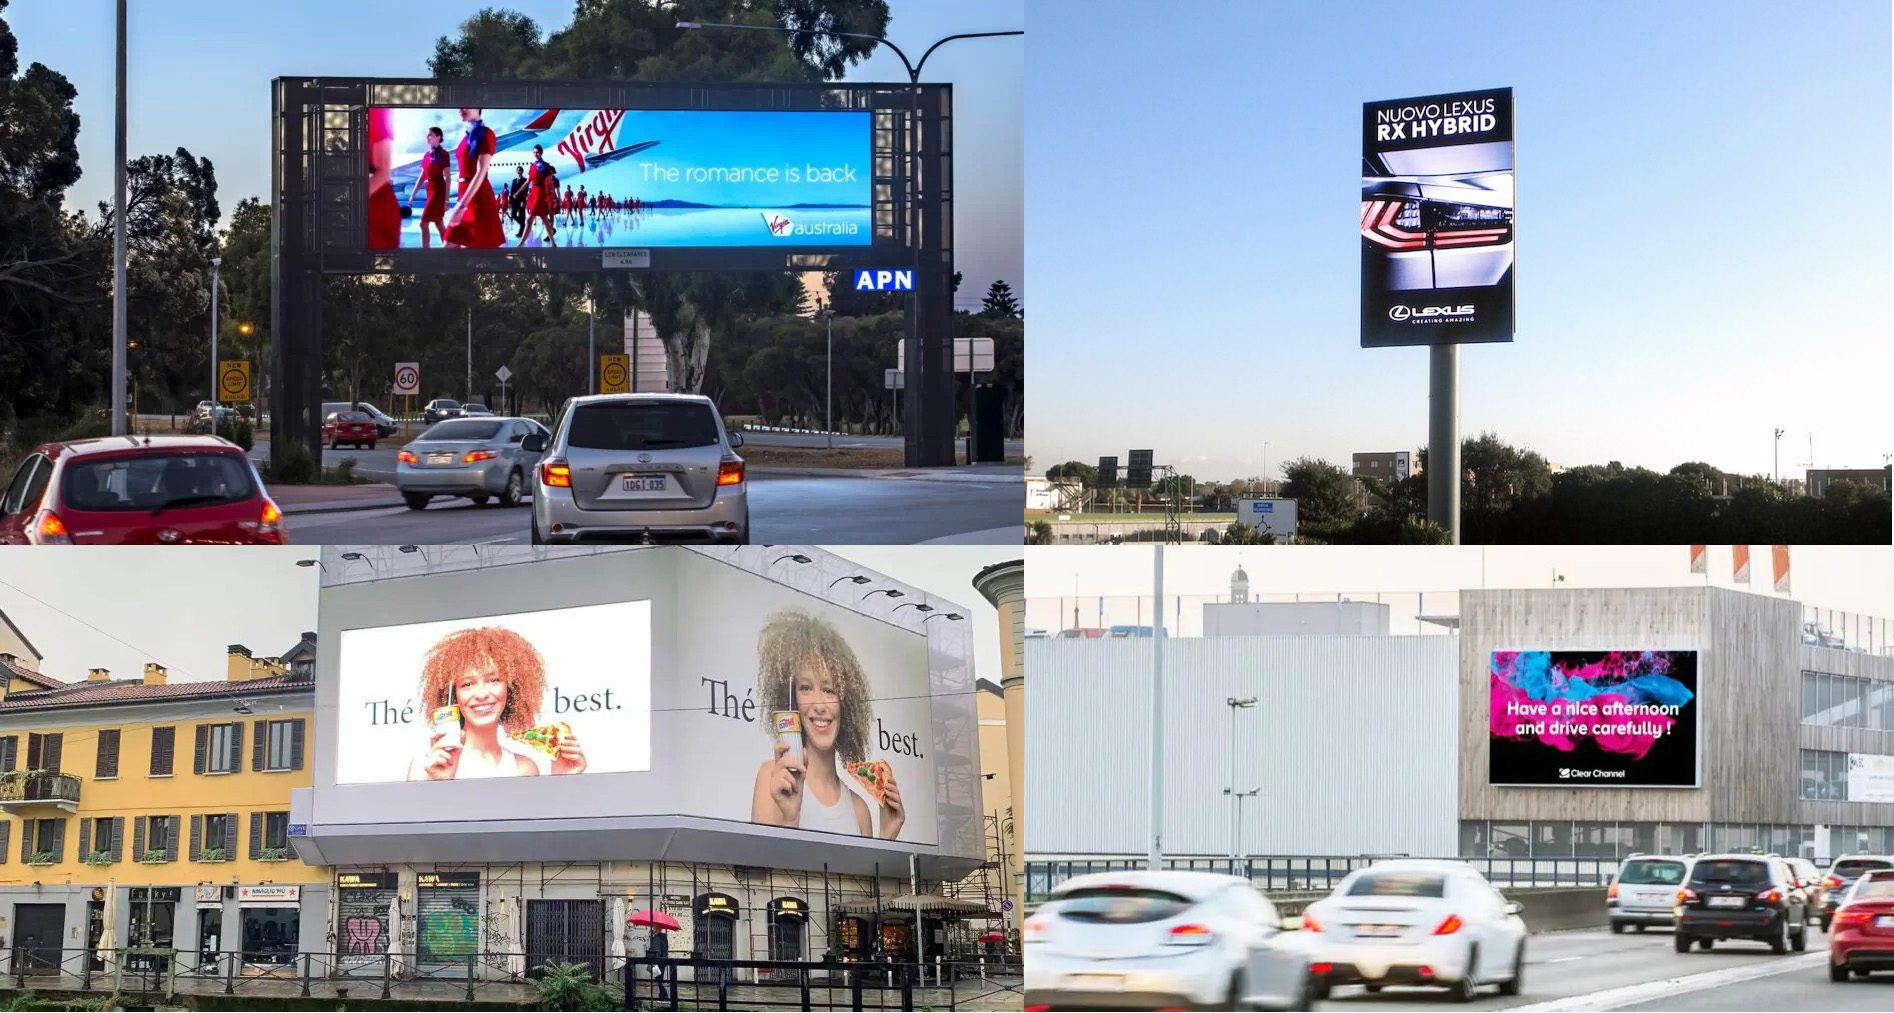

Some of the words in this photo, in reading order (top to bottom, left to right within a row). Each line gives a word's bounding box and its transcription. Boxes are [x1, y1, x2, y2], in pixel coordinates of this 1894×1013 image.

[1378, 104, 1440, 123] NUOVO
[1443, 99, 1495, 117] LEXUS
[1377, 123, 1407, 141] RX
[1412, 114, 1496, 138] HYBRID
[640, 163, 680, 182] The
[686, 167, 779, 182] romance
[786, 163, 800, 182] is
[806, 163, 857, 182] back
[769, 215, 791, 234] Virgin
[794, 221, 858, 235] australia
[856, 270, 912, 290] APN
[1412, 304, 1475, 317] LEXUS
[400, 373, 415, 384] 60
[365, 697, 413, 725] Thé
[553, 687, 622, 714] best.
[1507, 702, 1547, 716] Have
[1551, 705, 1563, 716] a
[1566, 702, 1598, 716] nice
[1602, 702, 1680, 716] afternoon
[701, 676, 755, 722] Thé
[876, 718, 924, 759] best.
[1515, 721, 1545, 735] and
[1550, 721, 1588, 735] drive
[1592, 721, 1663, 739] carefully
[1570, 769, 1592, 778] Clear
[1593, 769, 1626, 778] Channel
[340, 875, 360, 883] KAWA
[131, 889, 173, 898] Fuky!
